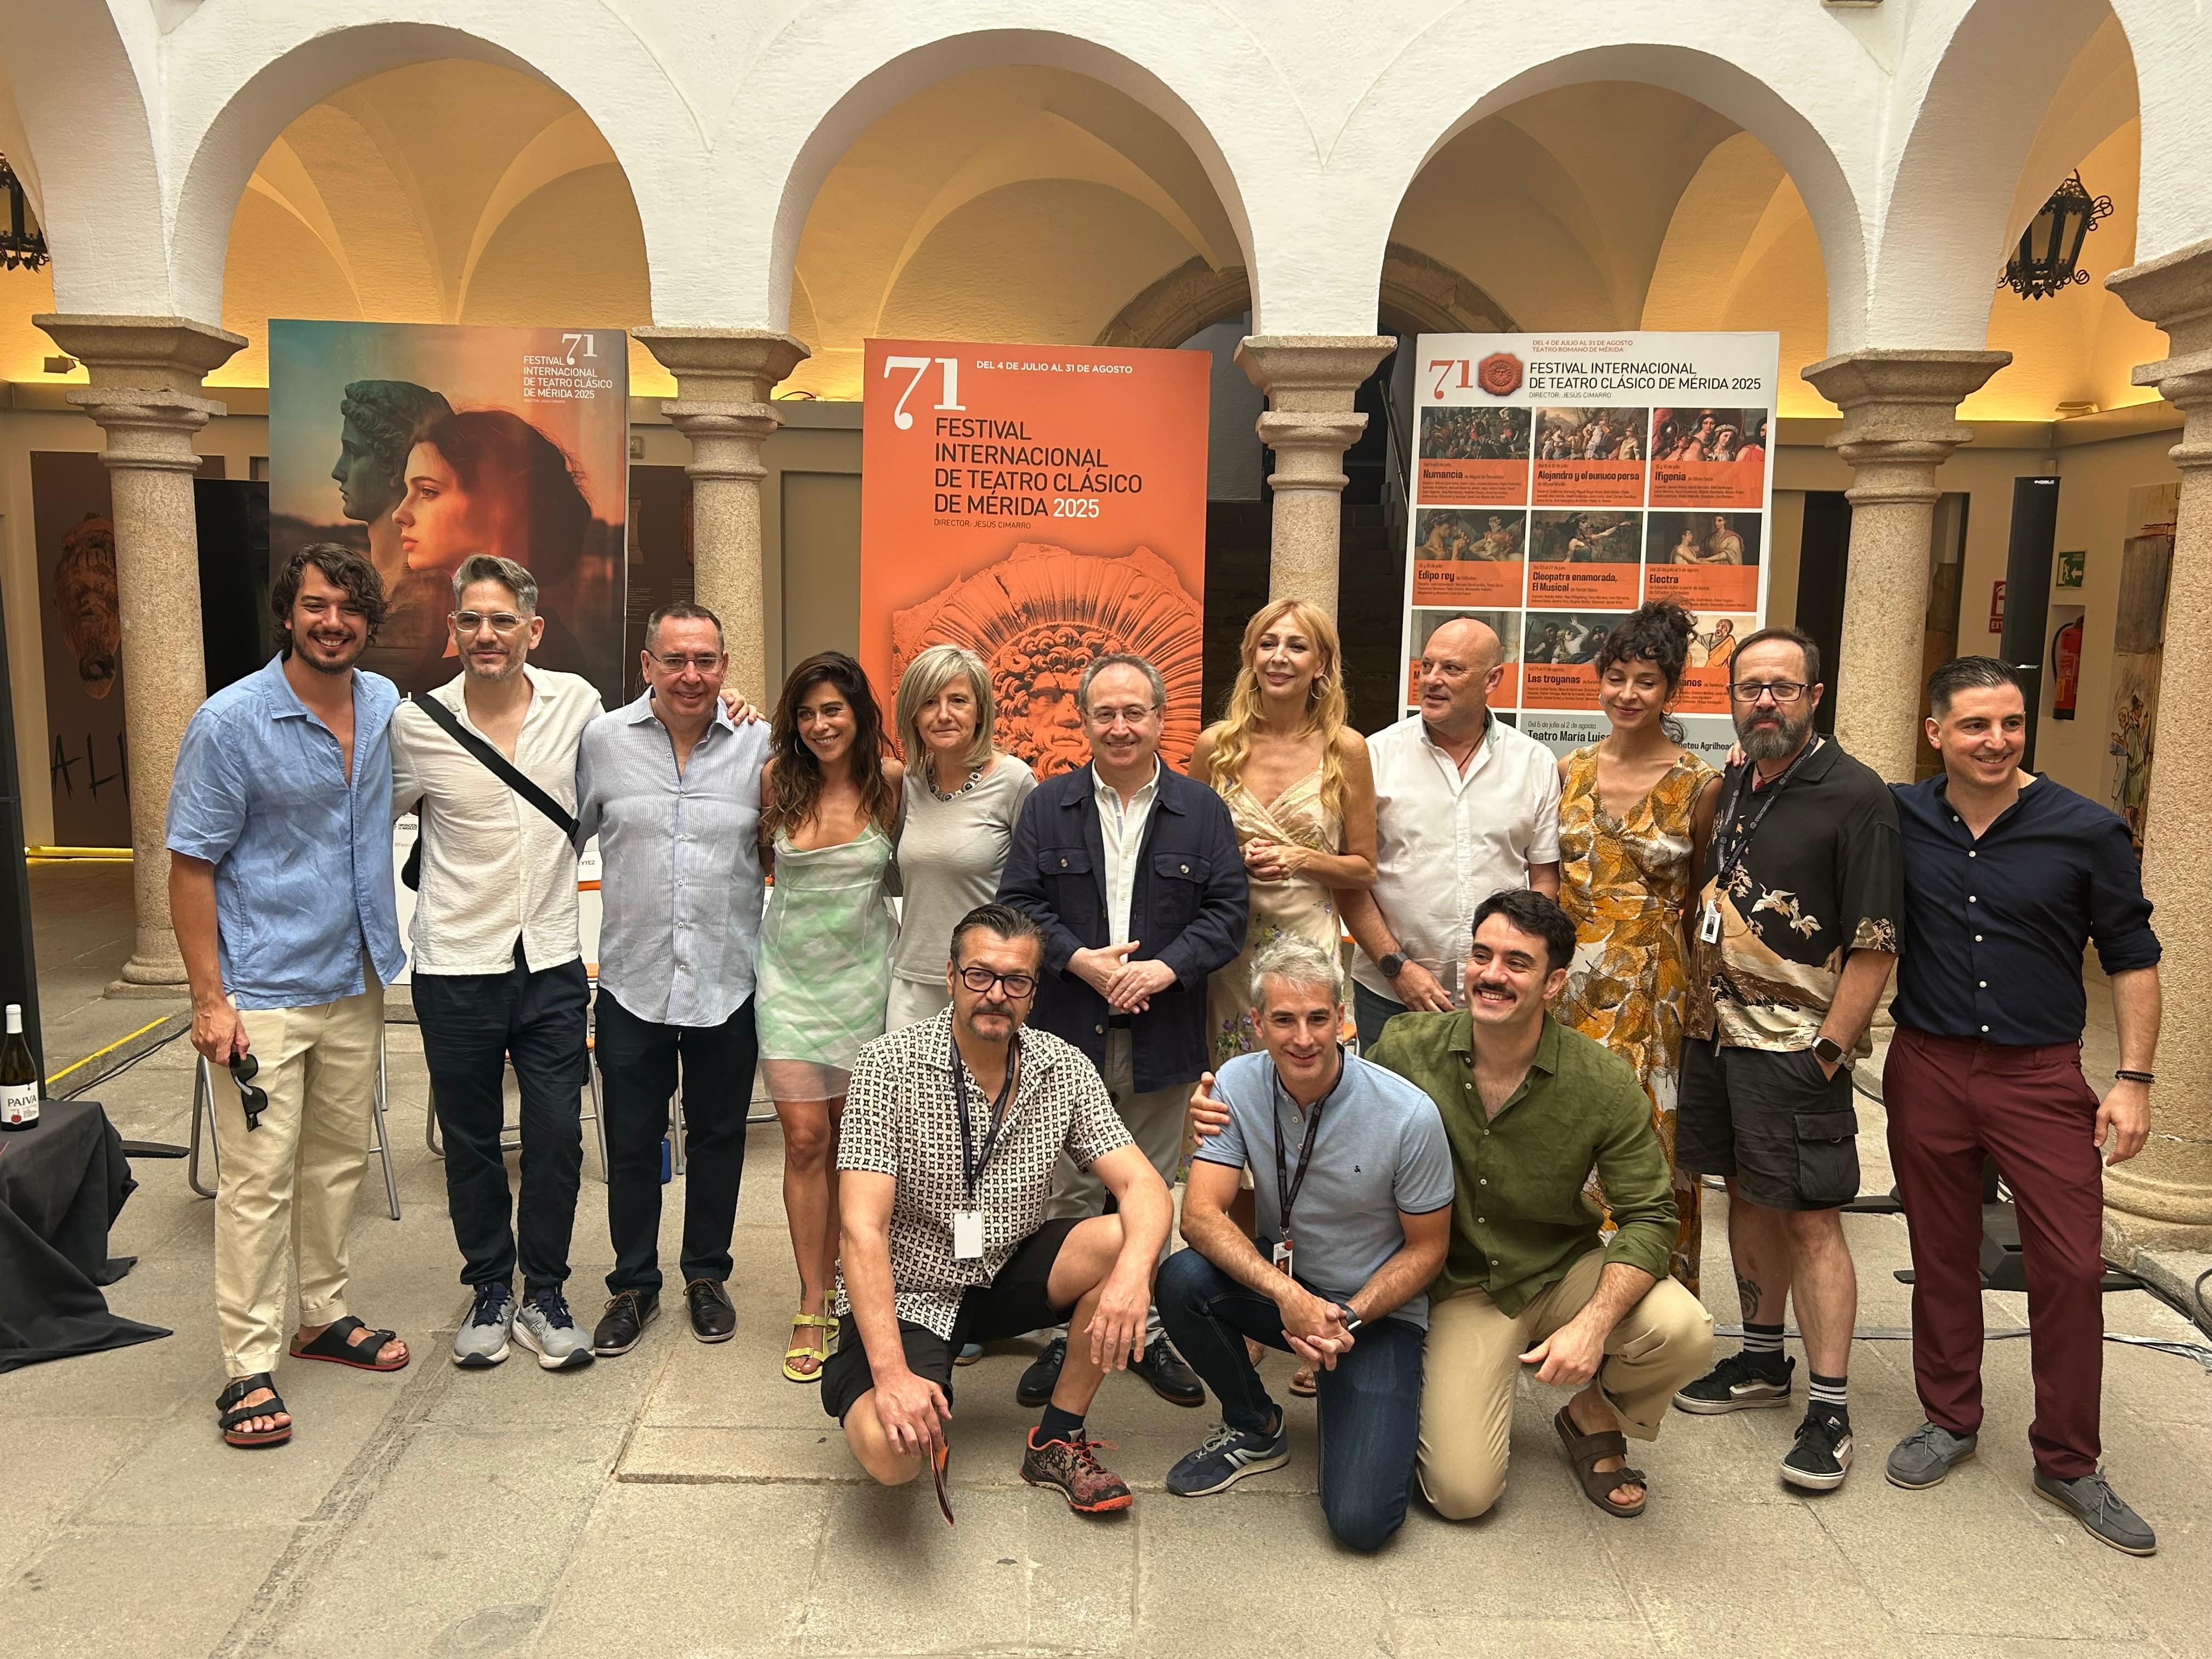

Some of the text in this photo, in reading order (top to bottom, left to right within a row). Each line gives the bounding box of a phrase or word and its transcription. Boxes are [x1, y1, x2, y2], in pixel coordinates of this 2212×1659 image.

[562, 333, 597, 365] 71
[524, 356, 565, 365] FESTIVAL
[524, 366, 597, 377] INTERNACIONAL
[977, 360, 1133, 374] DEL 4 DE JULIO AL 31 DE AGOSTO
[1530, 363, 1697, 374] FESTIVAL INTERNACIONAL
[524, 377, 612, 388] DE TEATRO CLÁSICO
[1429, 360, 1473, 399] 71
[1530, 374, 1761, 390] DE TEATRO CLÁSICO DE MÉRIDA 2025
[524, 386, 595, 398] DE MÉRIDA 2025
[883, 356, 966, 430] 71
[936, 417, 1031, 440] FESTIVAL
[935, 443, 1108, 467] INTERNACIONAL
[935, 467, 1142, 493] DE TEATRO CLÁSICO
[1423, 470, 1463, 479] Numancia
[1538, 471, 1573, 482] Alejandro
[1575, 473, 1579, 482] y
[1581, 471, 1588, 479] el
[1617, 473, 1639, 482] persa
[1655, 471, 1686, 483] Ifigenia
[935, 489, 1099, 518] DE MÉRIDA 2025
[973, 518, 996, 528] JESÚS
[1419, 570, 1454, 582] Edipo rey
[1533, 571, 1617, 583] Cleopatra enamorada,
[1650, 574, 1679, 583] Electra
[1532, 583, 1538, 591] El
[1540, 583, 1569, 591] Musical
[1528, 674, 1581, 685] Las troyanas
[1528, 730, 1558, 741] Teatro
[1560, 731, 1585, 742] María
[7, 1094, 37, 1107] PAIVA
